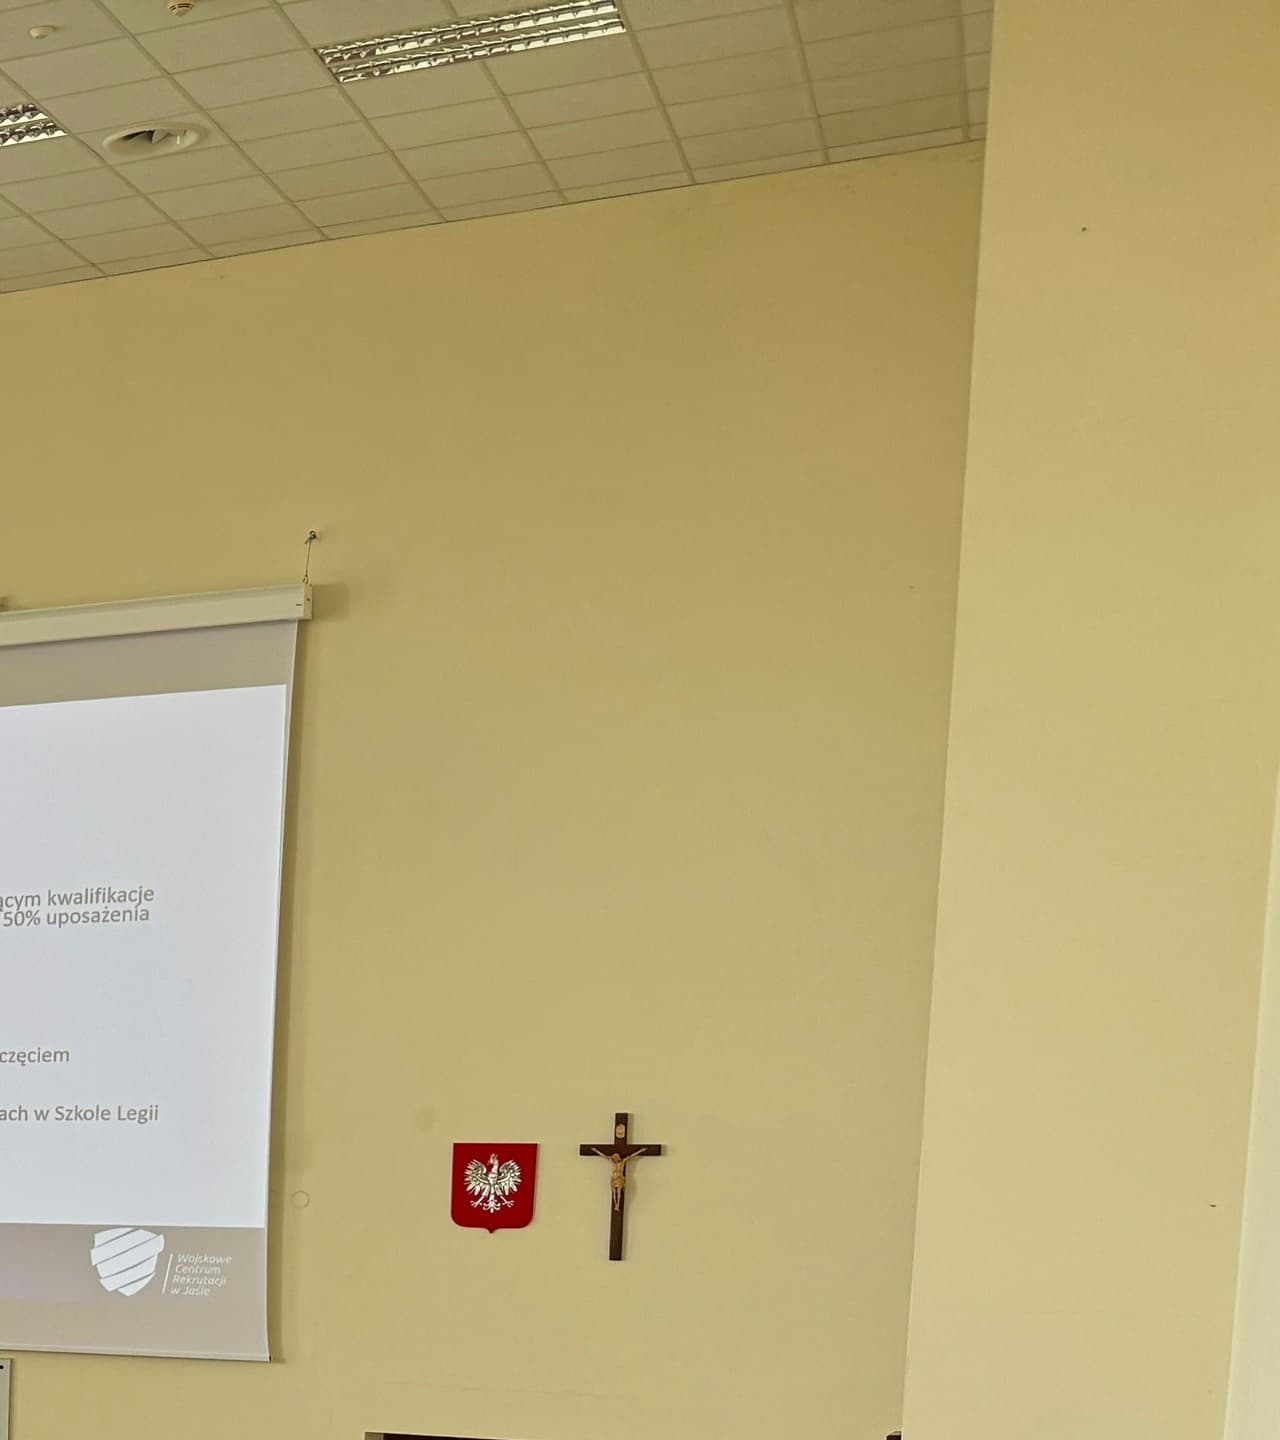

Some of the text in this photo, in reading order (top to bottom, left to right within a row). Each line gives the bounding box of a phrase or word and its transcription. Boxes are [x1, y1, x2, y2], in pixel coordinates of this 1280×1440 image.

[48, 886, 154, 909] kwalifikacje
[3, 910, 41, 927] 50%
[47, 907, 149, 928] uposażenia
[34, 1109, 49, 1120] w
[55, 1105, 111, 1121] Szkole
[118, 1105, 158, 1124] Legii
[177, 1253, 232, 1265] Wojskowe
[175, 1264, 221, 1274] Centrum
[172, 1275, 227, 1287] Rekrutacji
[170, 1285, 210, 1296] w Jaśle
